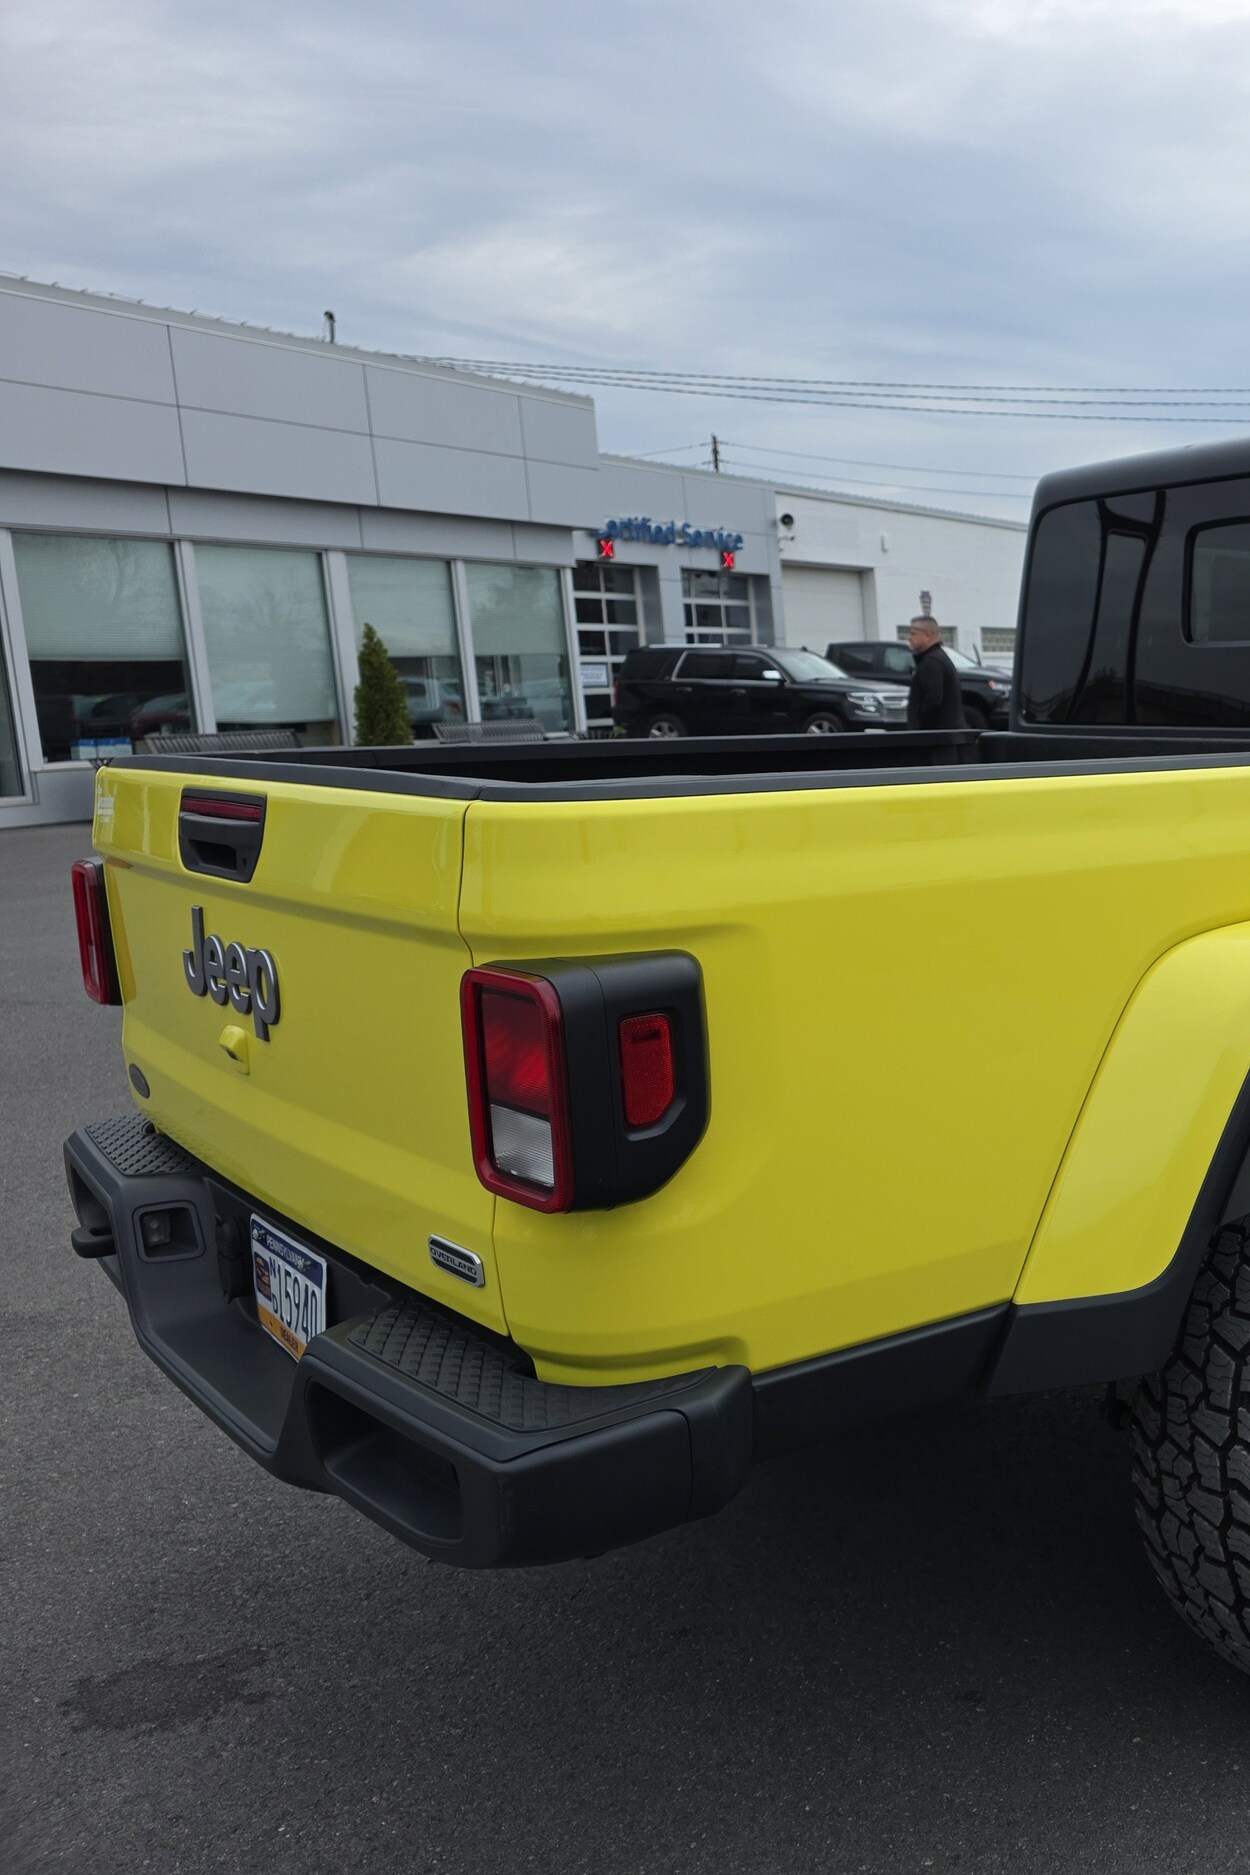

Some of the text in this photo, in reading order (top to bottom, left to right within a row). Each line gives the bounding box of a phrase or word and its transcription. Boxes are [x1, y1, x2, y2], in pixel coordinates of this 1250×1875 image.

[676, 521, 744, 550] Service
[182, 905, 281, 1043] Jeep
[429, 1246, 477, 1276] OVERLAND
[280, 1325, 299, 1354] DEALER
